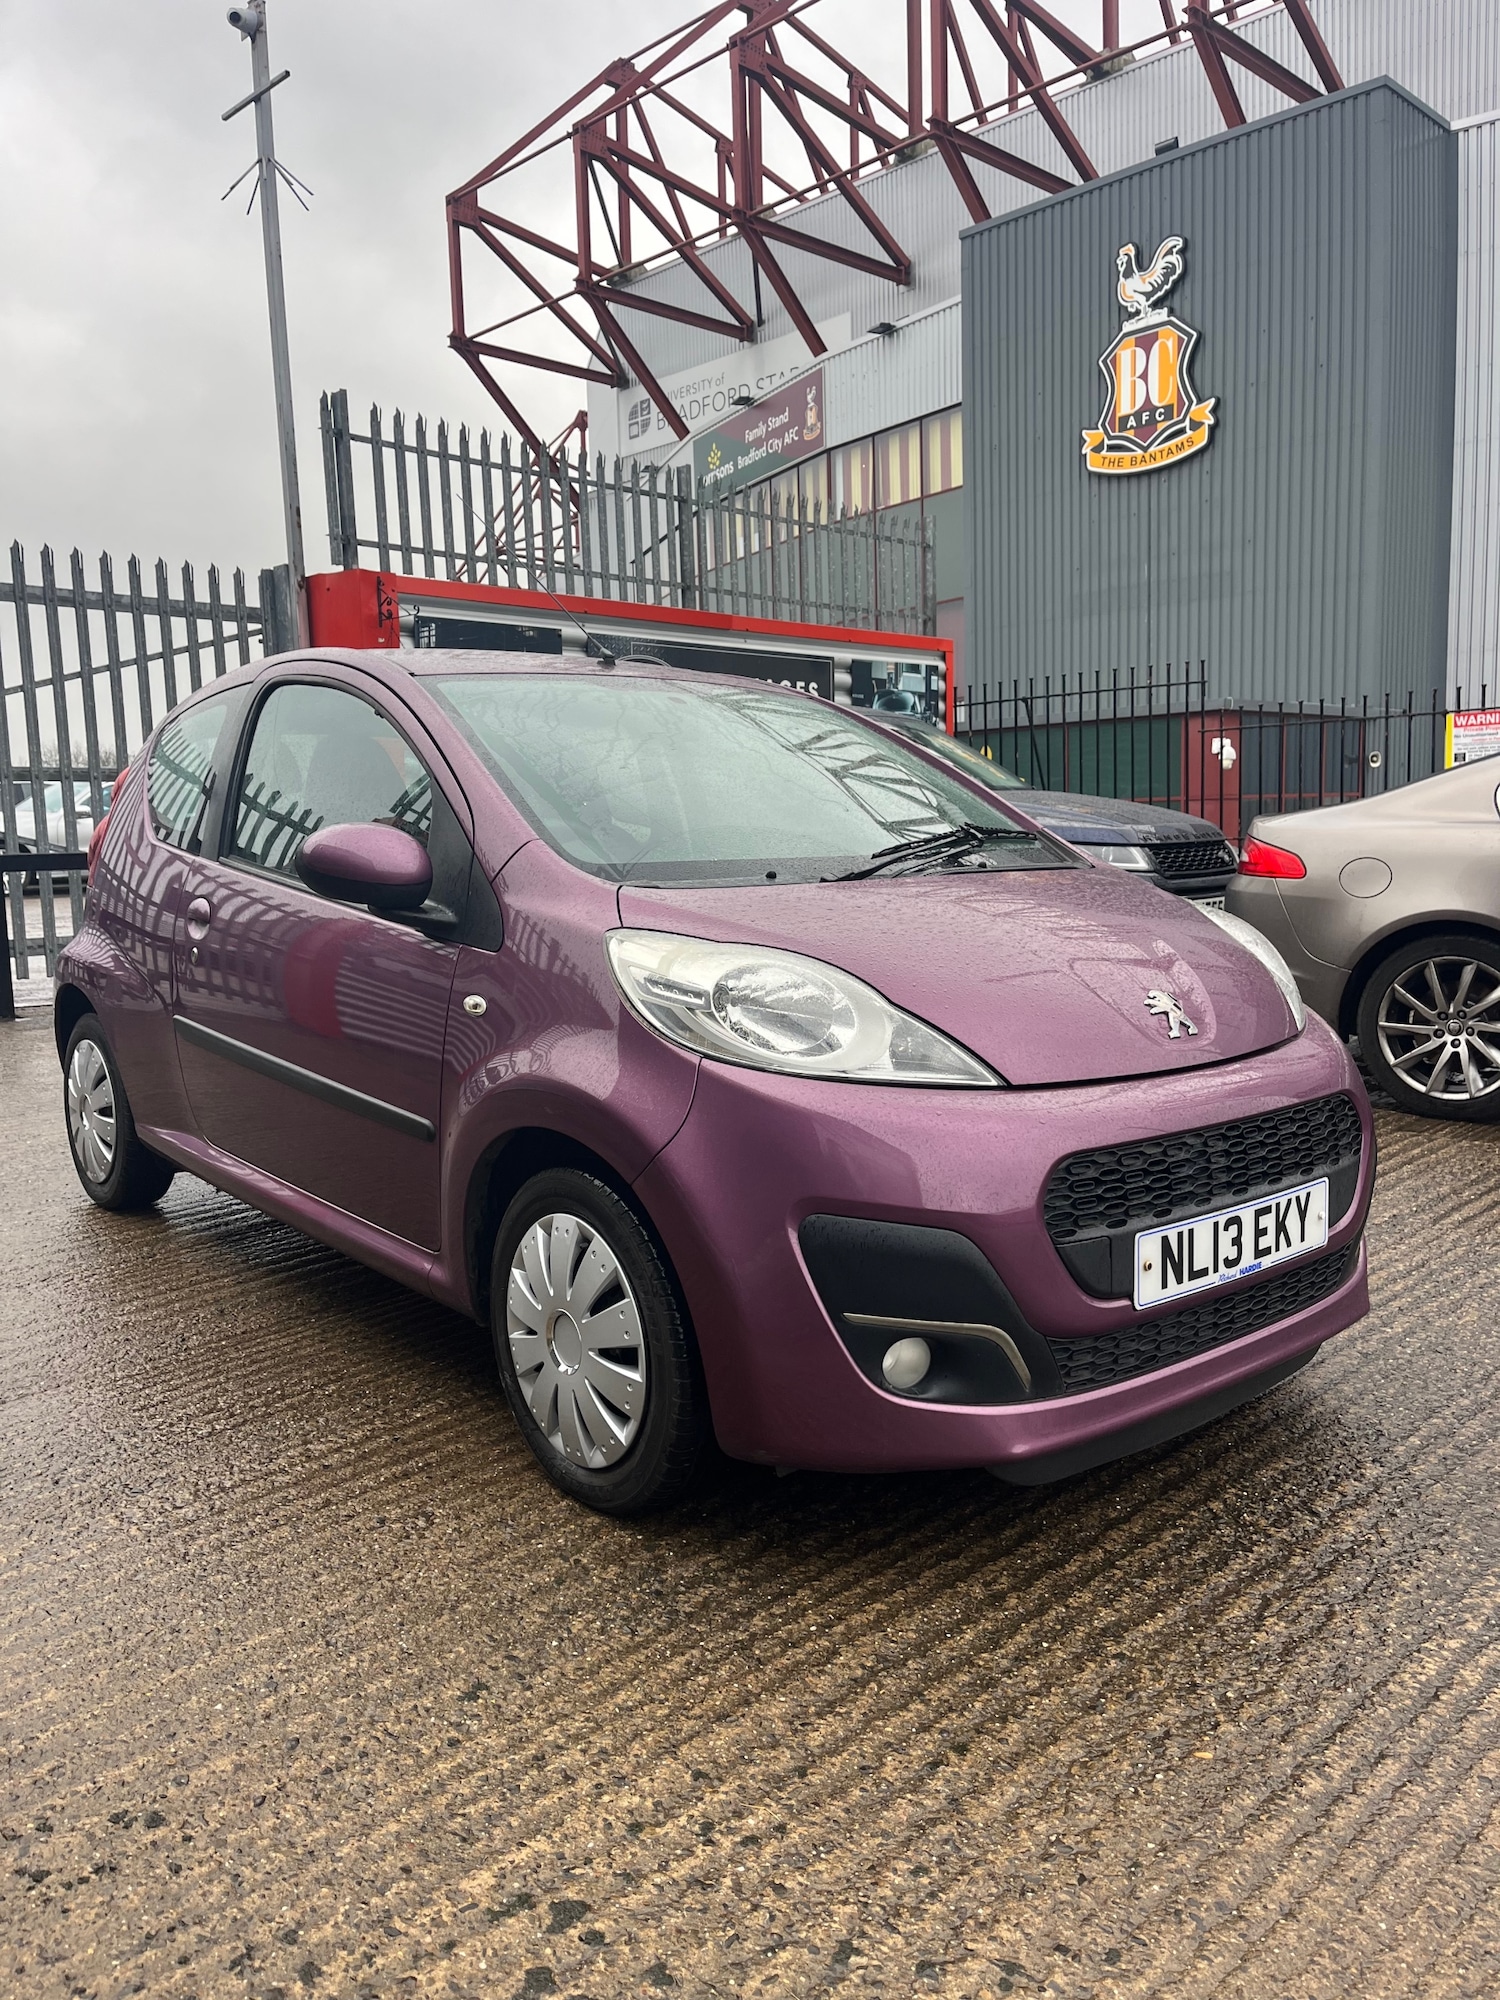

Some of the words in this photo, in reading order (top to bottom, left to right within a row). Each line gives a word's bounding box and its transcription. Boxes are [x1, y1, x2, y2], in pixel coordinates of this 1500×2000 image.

[668, 377, 713, 401] IVERSITY
[715, 371, 725, 387] of
[1117, 337, 1173, 417] BC
[656, 383, 751, 431] BADFORD
[1126, 408, 1165, 429] AFC
[745, 421, 767, 444] Family
[767, 407, 789, 431] Stand
[737, 442, 767, 469] Bradford
[767, 436, 783, 456] City
[783, 426, 799, 448] AFC
[1101, 456, 1124, 468] THE
[1129, 436, 1195, 467] BANTAMS
[697, 461, 735, 487] orrisons
[1161, 1215, 1243, 1290] NL13
[1254, 1191, 1311, 1261] EKY
[1239, 1261, 1263, 1277] HARDIE
